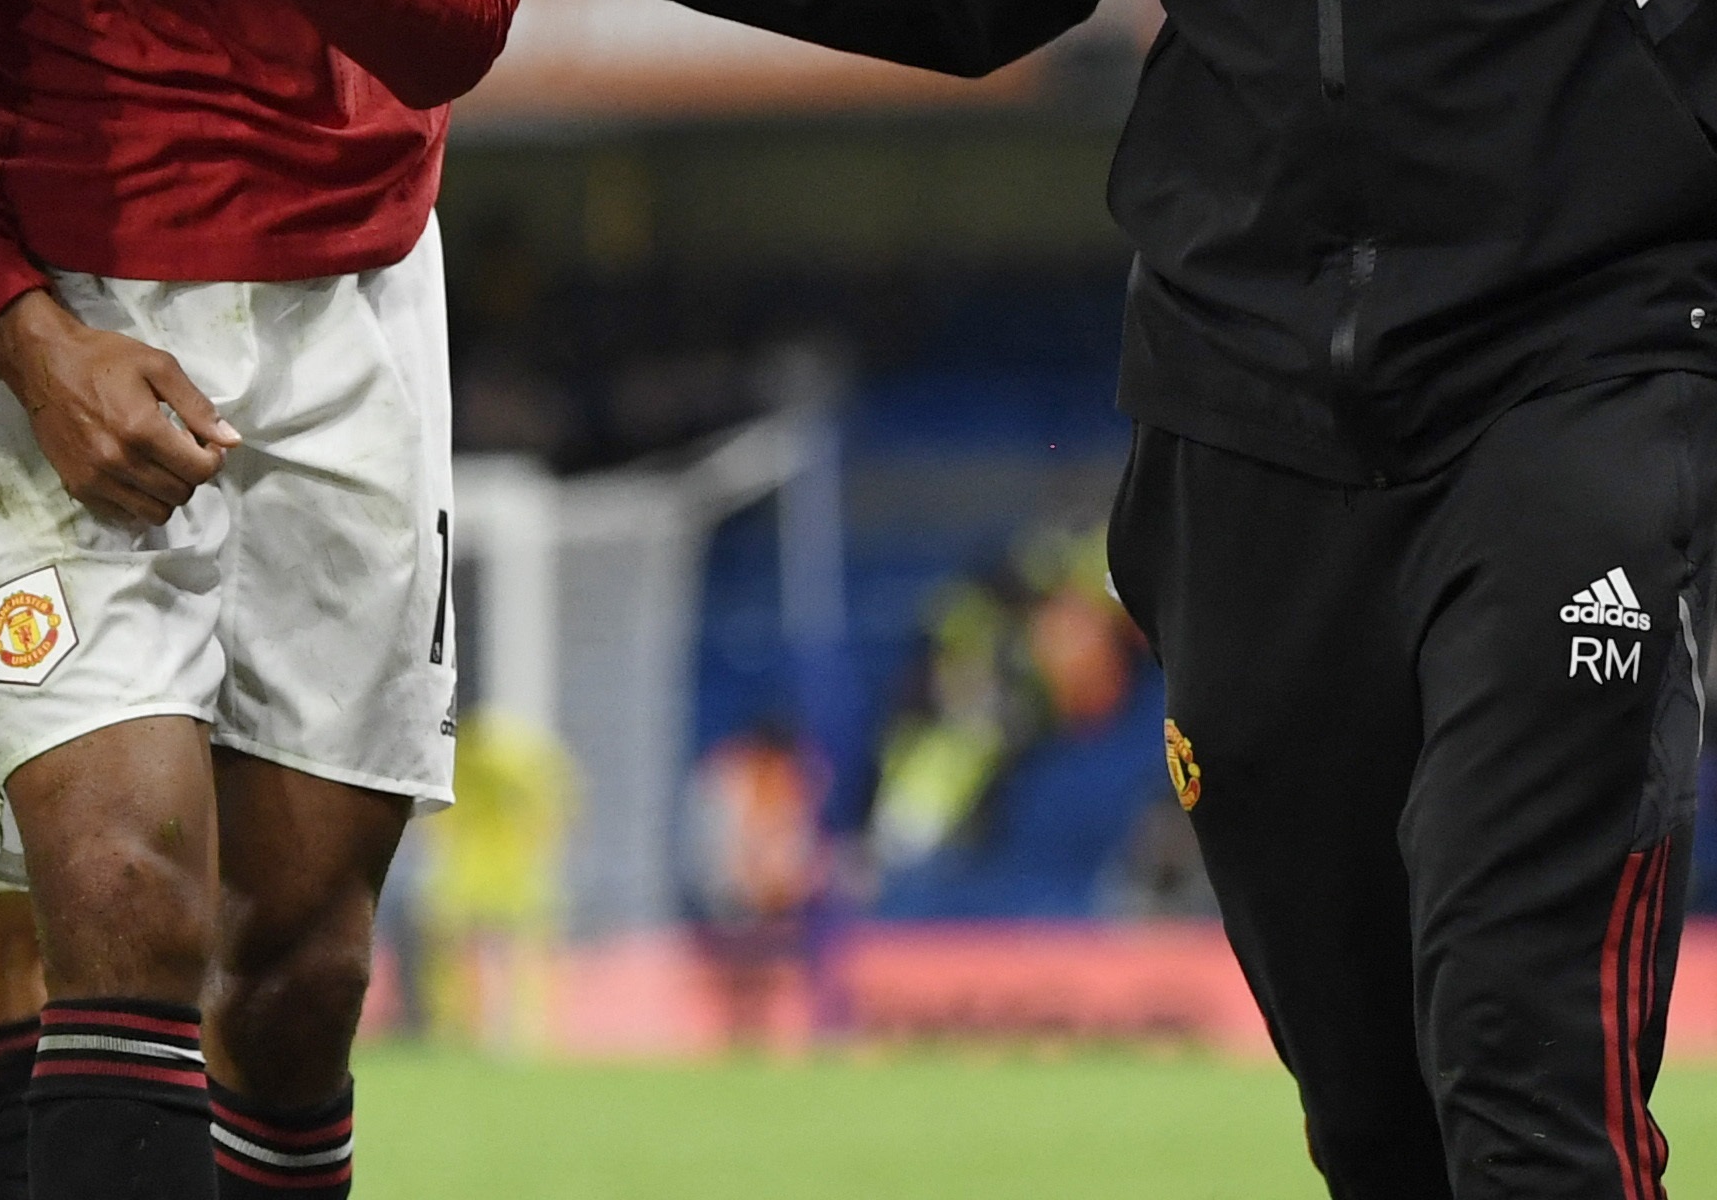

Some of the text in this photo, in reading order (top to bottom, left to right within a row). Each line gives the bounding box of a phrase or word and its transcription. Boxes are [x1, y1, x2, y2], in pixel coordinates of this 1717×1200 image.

[1559, 601, 1652, 631] adidas
[11, 641, 51, 665] UNITED
[1568, 636, 1642, 685] RM
